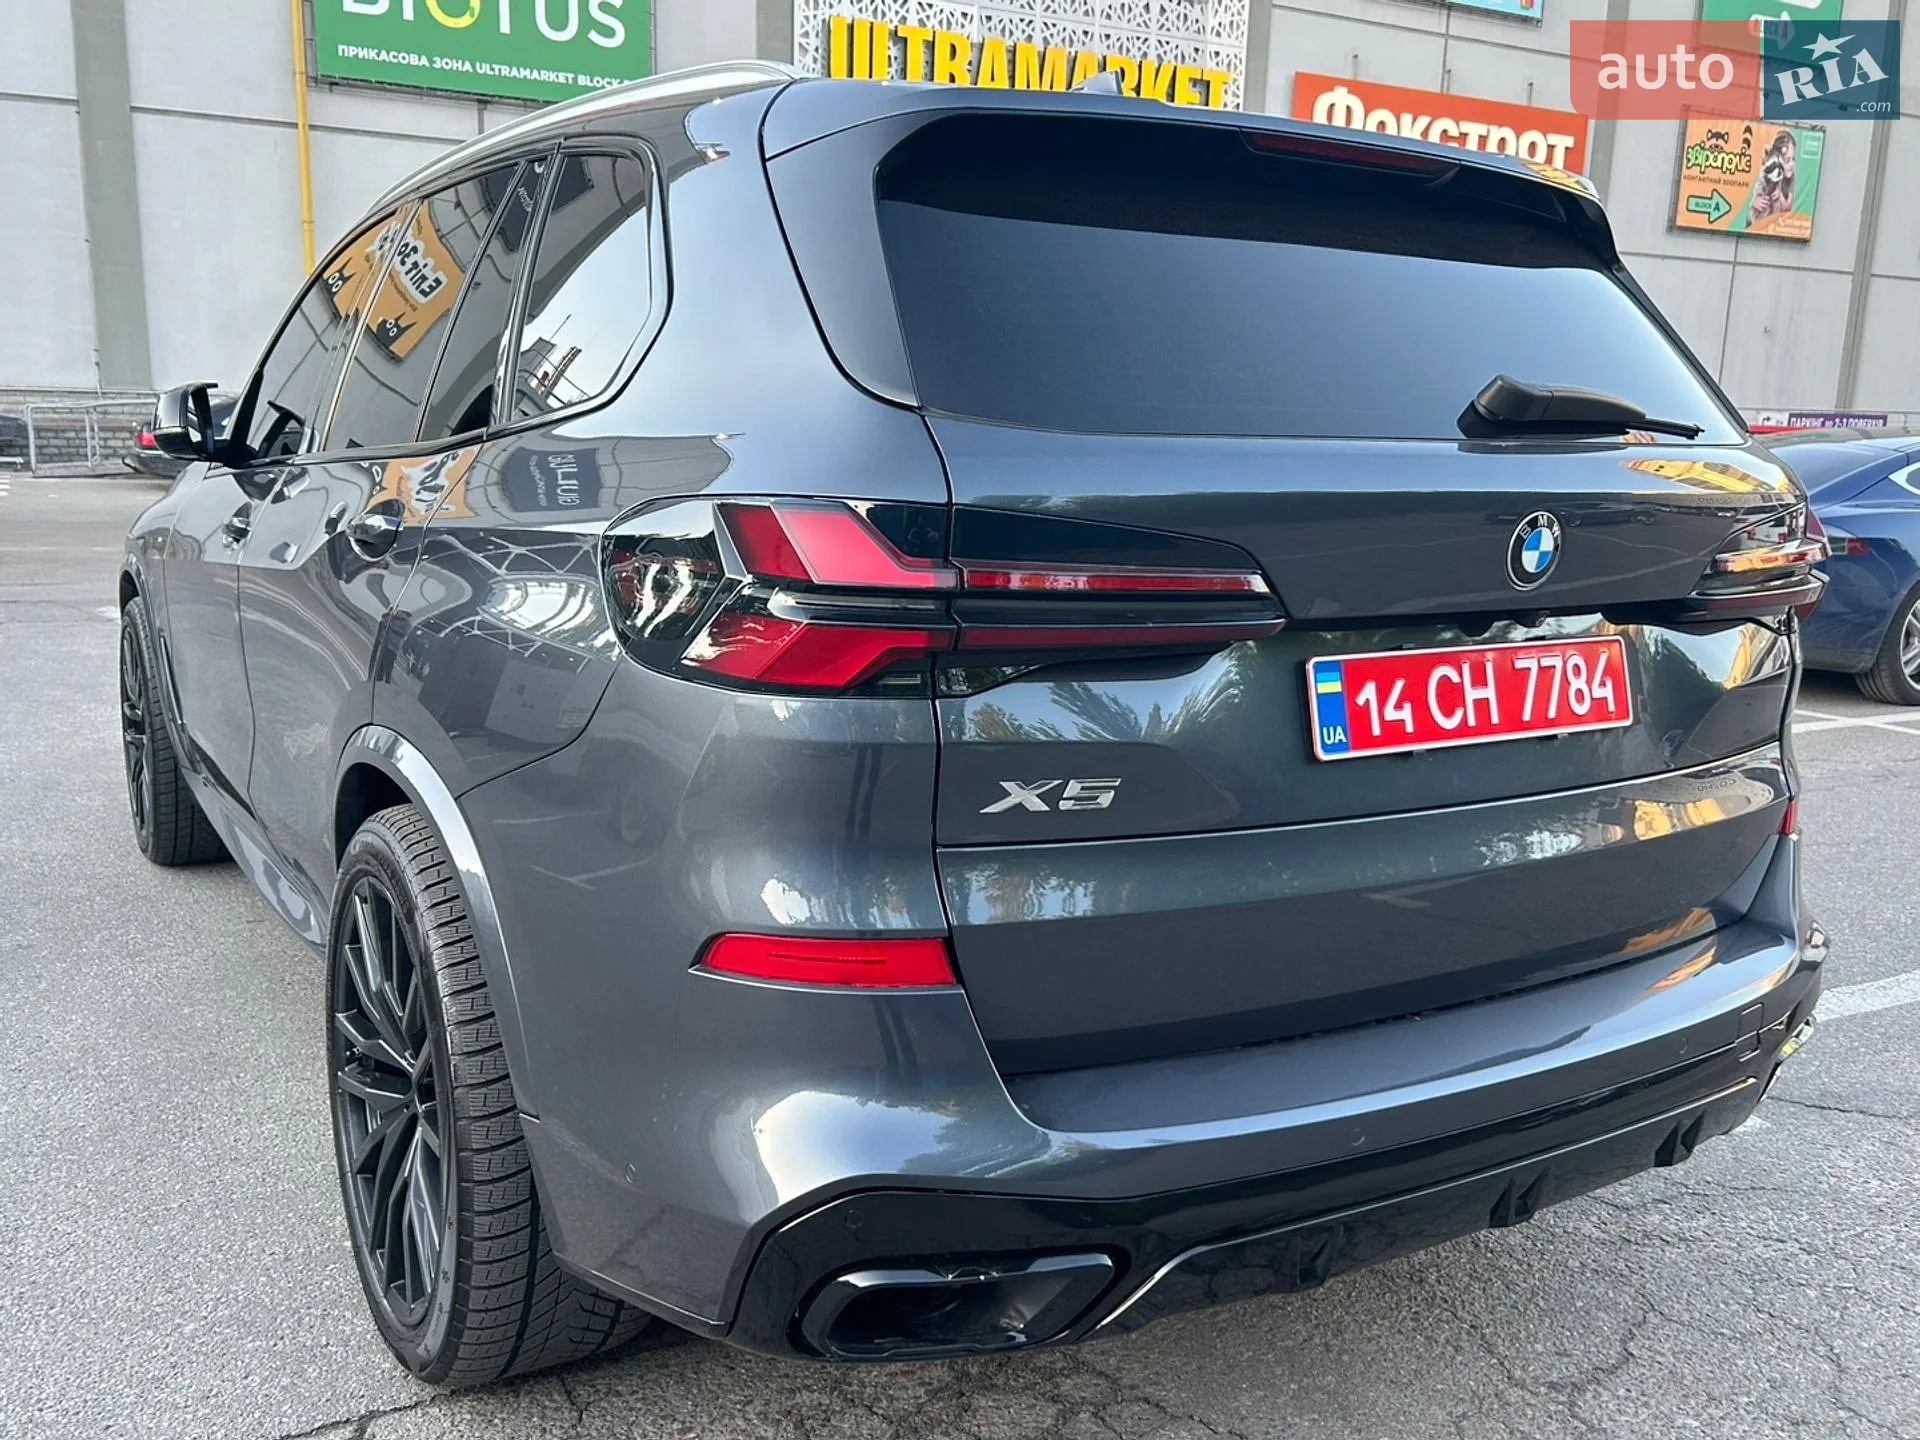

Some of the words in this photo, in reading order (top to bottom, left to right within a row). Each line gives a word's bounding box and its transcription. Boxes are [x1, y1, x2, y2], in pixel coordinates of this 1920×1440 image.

[338, 45, 429, 68] ПРИКАСОВА
[432, 56, 473, 73] ЗОНА
[476, 61, 574, 85] ULTRAMARKET
[577, 74, 620, 88] BLOCK
[1312, 86, 1574, 170] Фокстрот
[1694, 201, 1711, 209] BLOCK
[1713, 201, 1720, 212] A
[1519, 514, 1560, 540] BMW
[1355, 678, 1414, 737] 14
[1427, 659, 1500, 730] CH
[1513, 648, 1616, 722] 7784
[1322, 726, 1347, 745] UA
[978, 777, 1122, 814] X5
